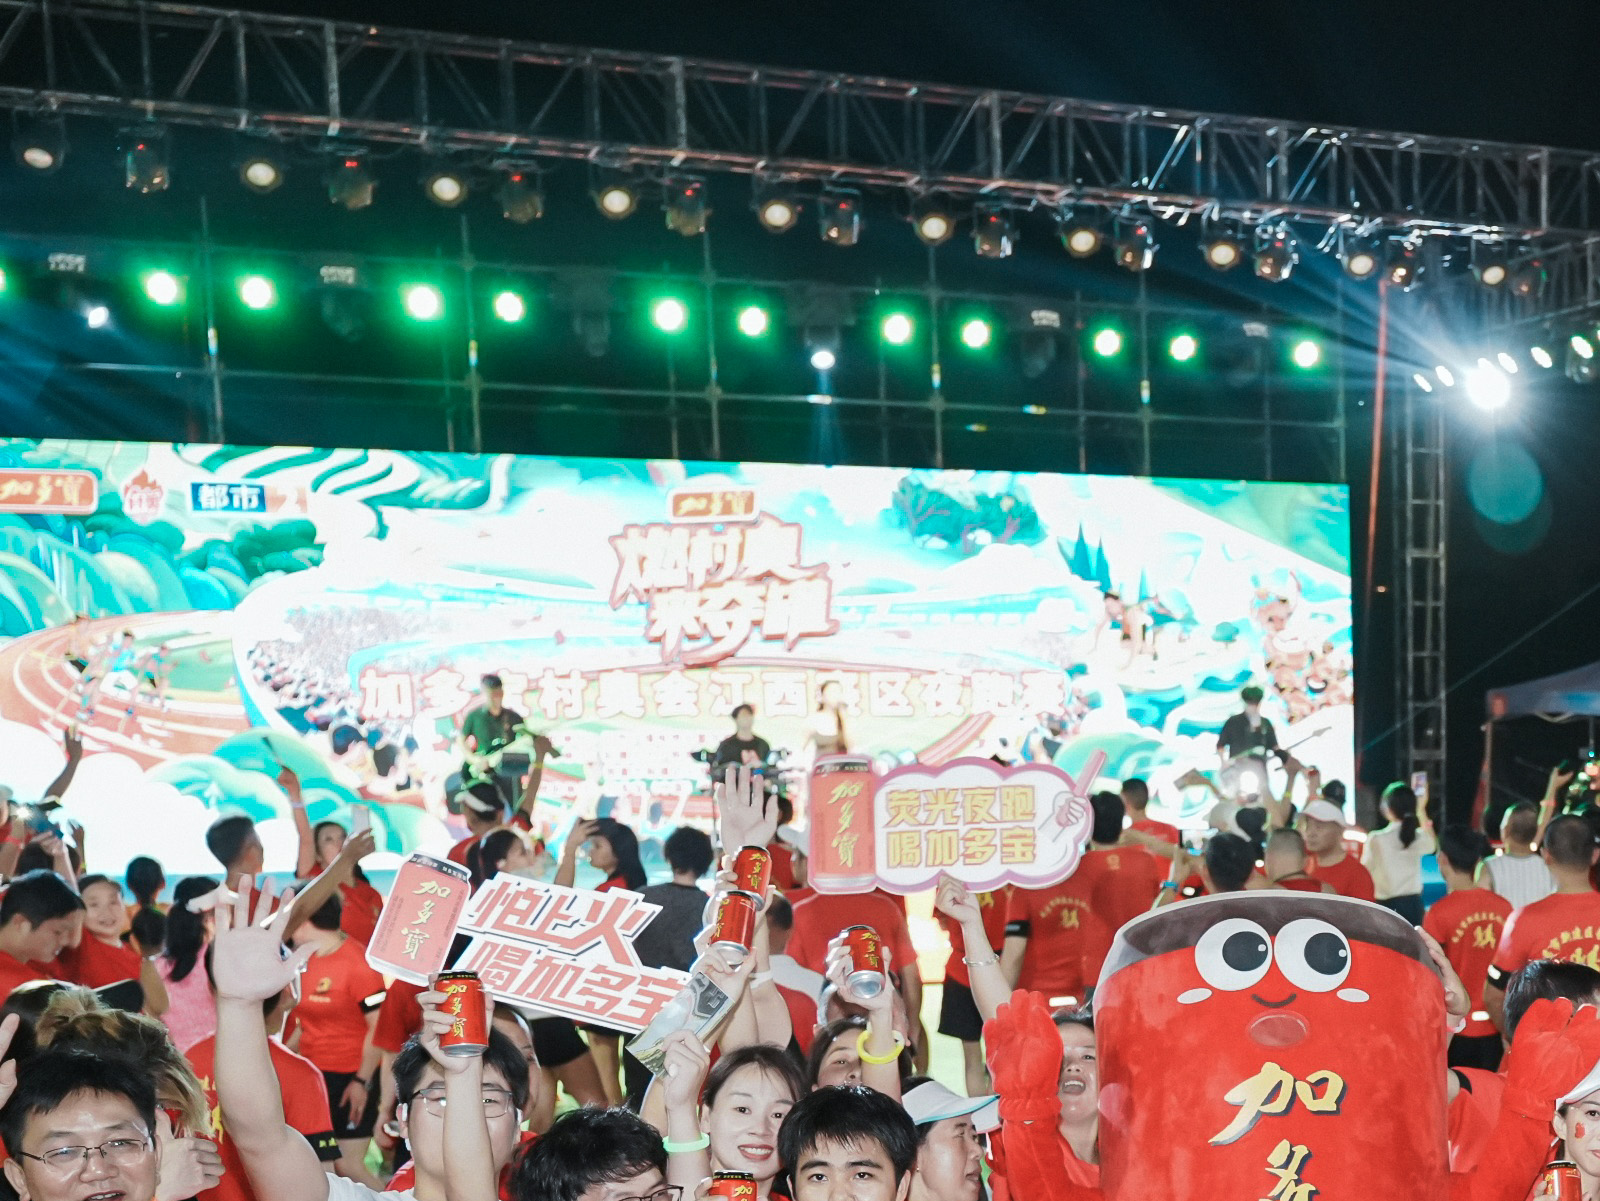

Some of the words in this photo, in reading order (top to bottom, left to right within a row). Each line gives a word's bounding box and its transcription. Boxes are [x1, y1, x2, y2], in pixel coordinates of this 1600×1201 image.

[199, 484, 261, 511] 都市
[882, 785, 1036, 828] 荧光夜跑
[886, 826, 1037, 868] 喝加多宝
[470, 880, 650, 969] 怕上火
[468, 940, 688, 1027] 喝加多宝
